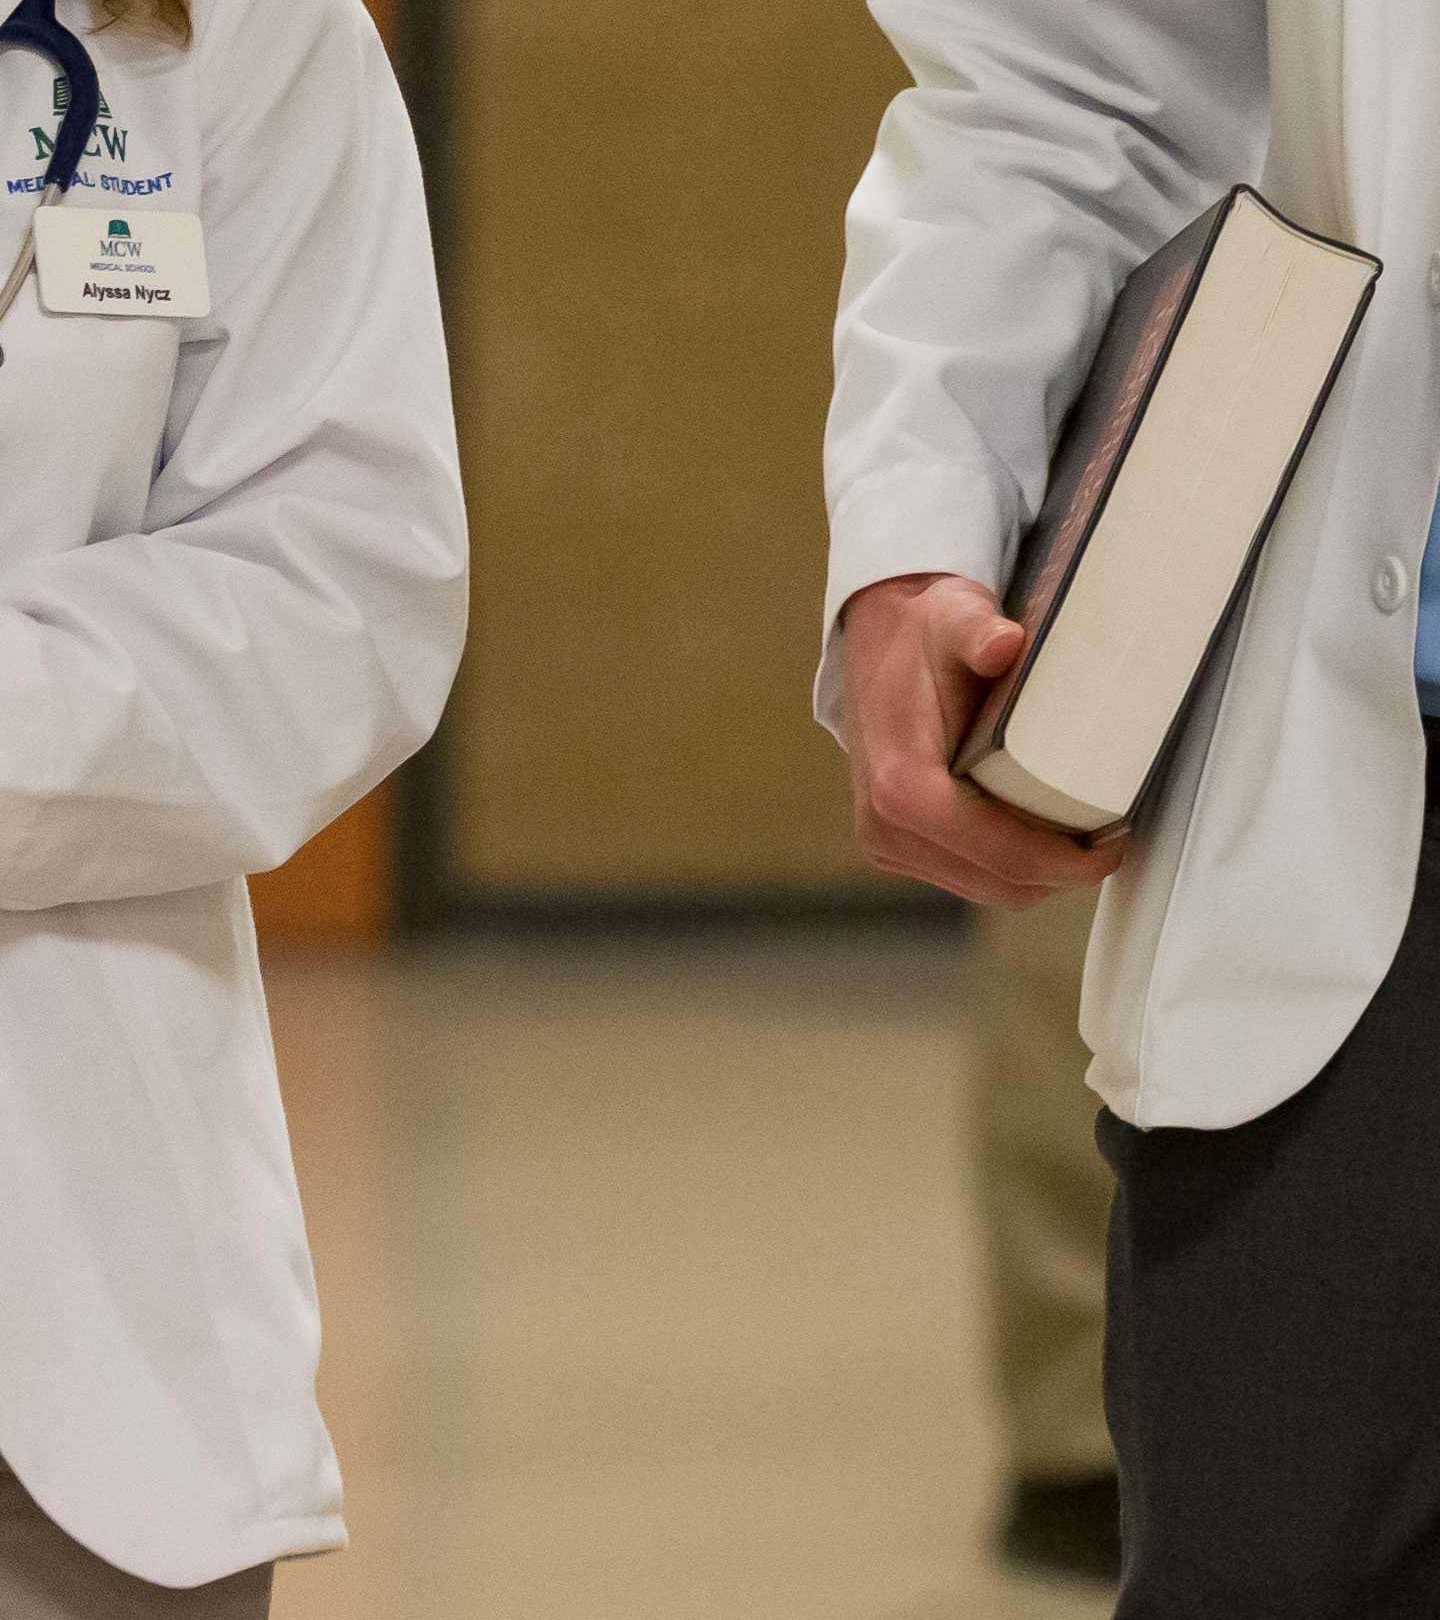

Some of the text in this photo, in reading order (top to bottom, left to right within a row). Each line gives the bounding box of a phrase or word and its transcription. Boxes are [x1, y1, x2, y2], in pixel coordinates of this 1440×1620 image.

[7, 171, 173, 196] MEDAL STUDENT
[100, 240, 142, 257] MCW
[82, 282, 172, 304] Alyssa Nycz
